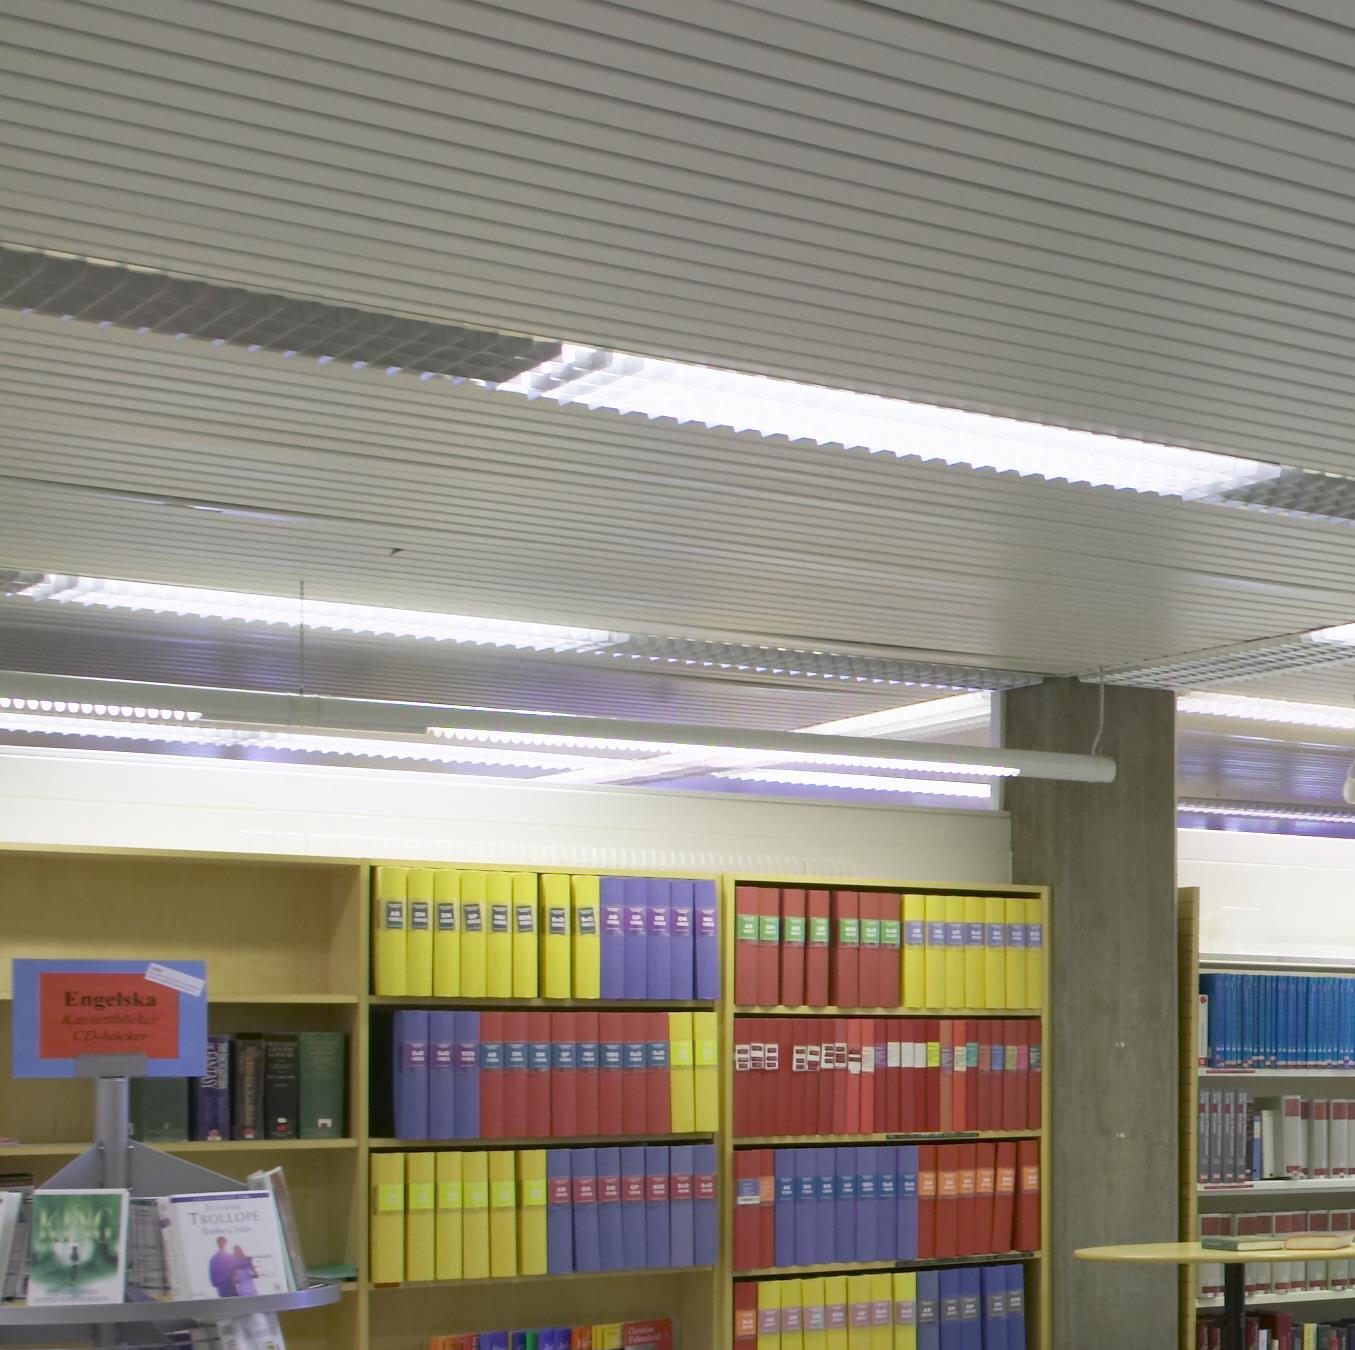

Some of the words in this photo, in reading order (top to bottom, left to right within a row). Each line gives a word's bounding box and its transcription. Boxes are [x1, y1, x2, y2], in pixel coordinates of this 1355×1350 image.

[64, 991, 157, 1010] Engelska
[38, 1206, 113, 1243] KING
[188, 1210, 261, 1226] TROLLOPE
